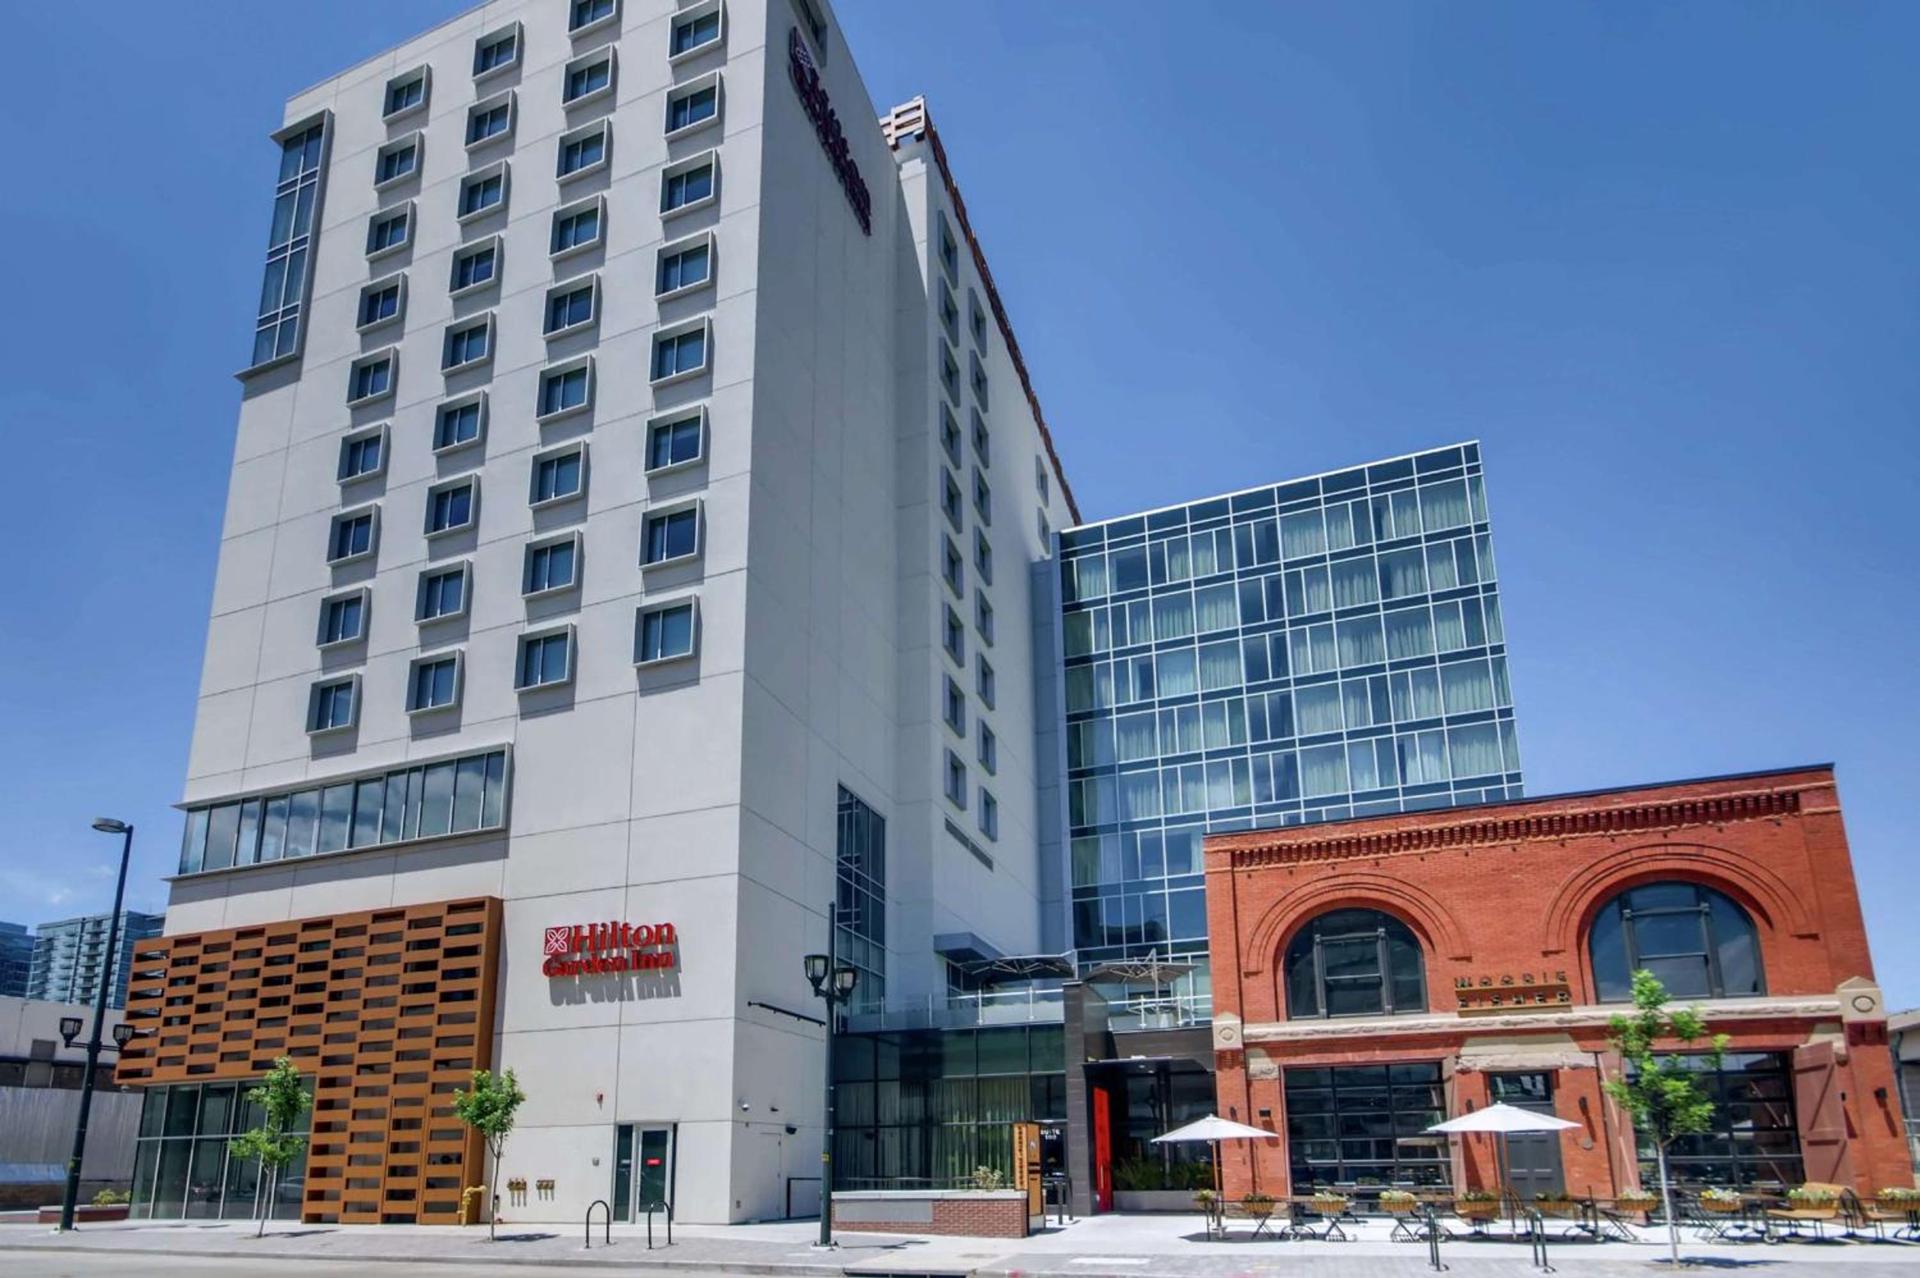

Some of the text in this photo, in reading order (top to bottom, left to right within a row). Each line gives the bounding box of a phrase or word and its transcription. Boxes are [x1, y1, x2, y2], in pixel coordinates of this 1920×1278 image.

[572, 921, 676, 953] Hilton
[543, 950, 673, 977] Garden Inn
